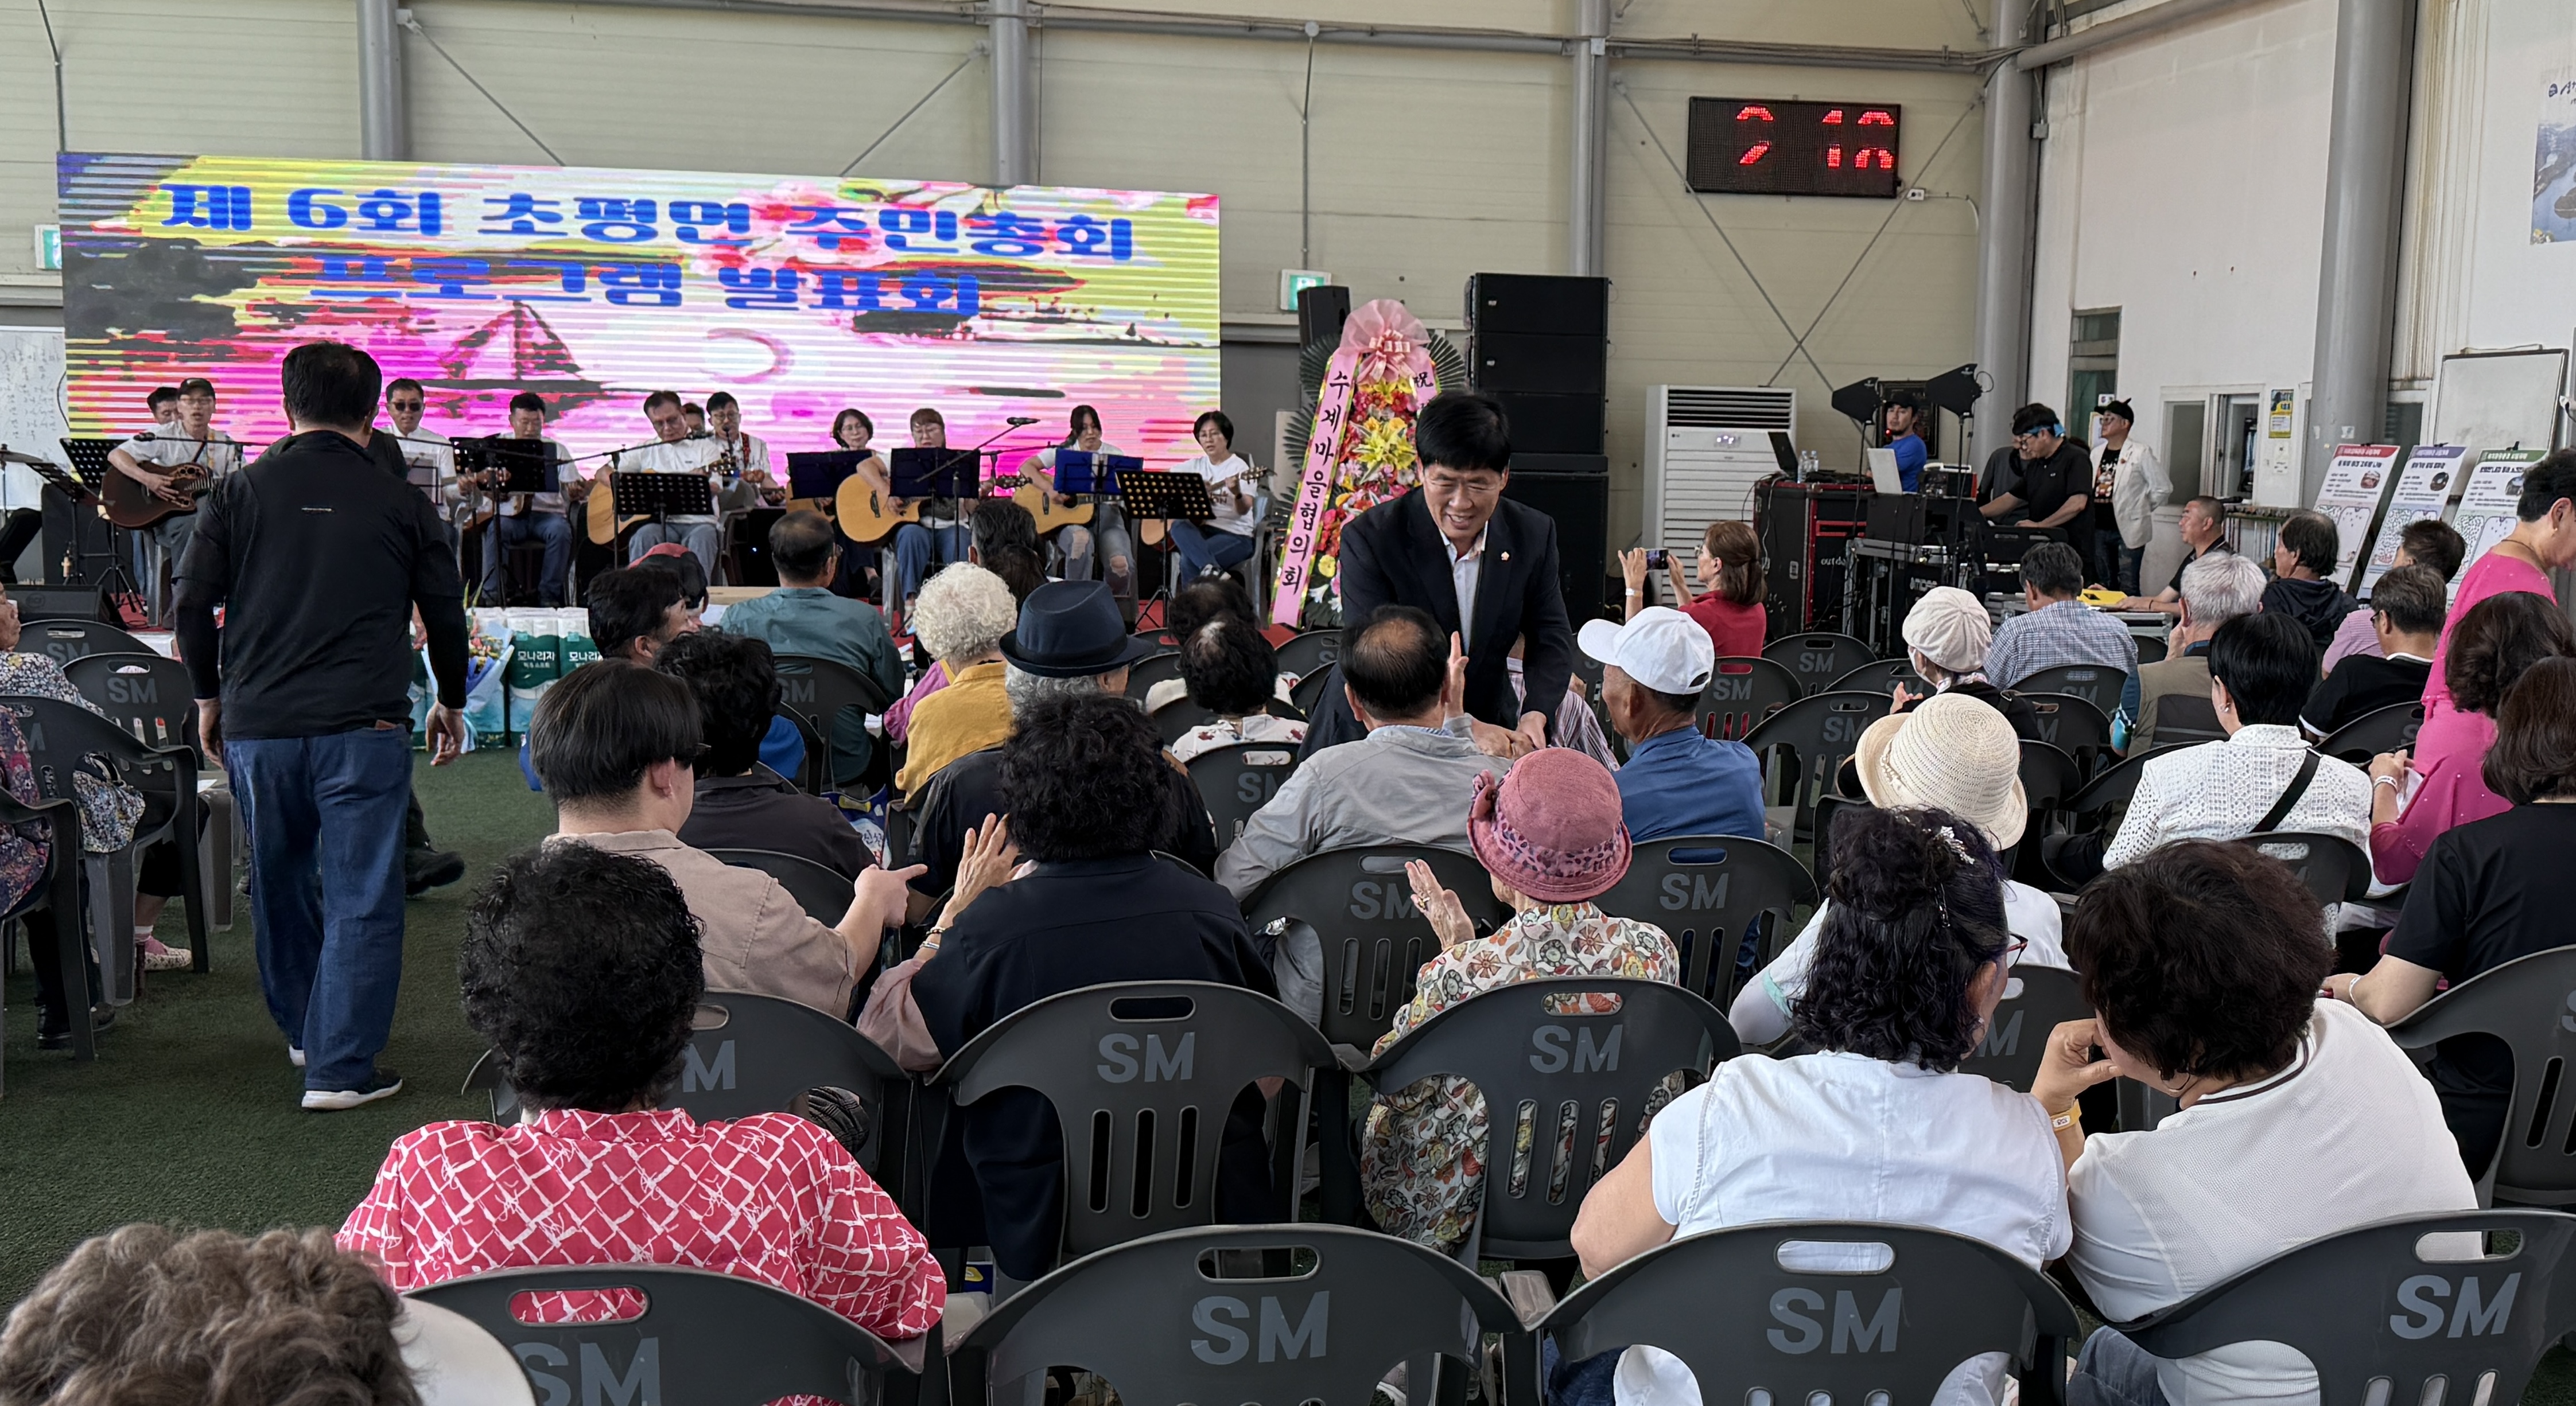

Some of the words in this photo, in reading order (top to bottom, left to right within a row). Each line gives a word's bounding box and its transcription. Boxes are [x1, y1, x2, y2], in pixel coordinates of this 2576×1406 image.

[160, 184, 251, 229] 제
[287, 188, 441, 235] 6회
[478, 193, 752, 246] 초평면
[785, 205, 1132, 259] 주민총회
[310, 254, 682, 307] 프로그램
[718, 267, 979, 317] 발표회
[518, 651, 555, 661] 모나리자
[1799, 652, 1834, 672] SM
[107, 677, 158, 703] SM
[1713, 679, 1753, 700] SM
[2037, 718, 2059, 742] M
[1660, 873, 1729, 910] SM
[1097, 1032, 1195, 1082] SM
[1529, 1025, 1623, 1073] SM
[1976, 1010, 2024, 1057] M
[683, 1039, 736, 1092] M
[1191, 1291, 1330, 1365] SM
[1766, 1287, 1902, 1354] SM
[2389, 1272, 2521, 1339] SM
